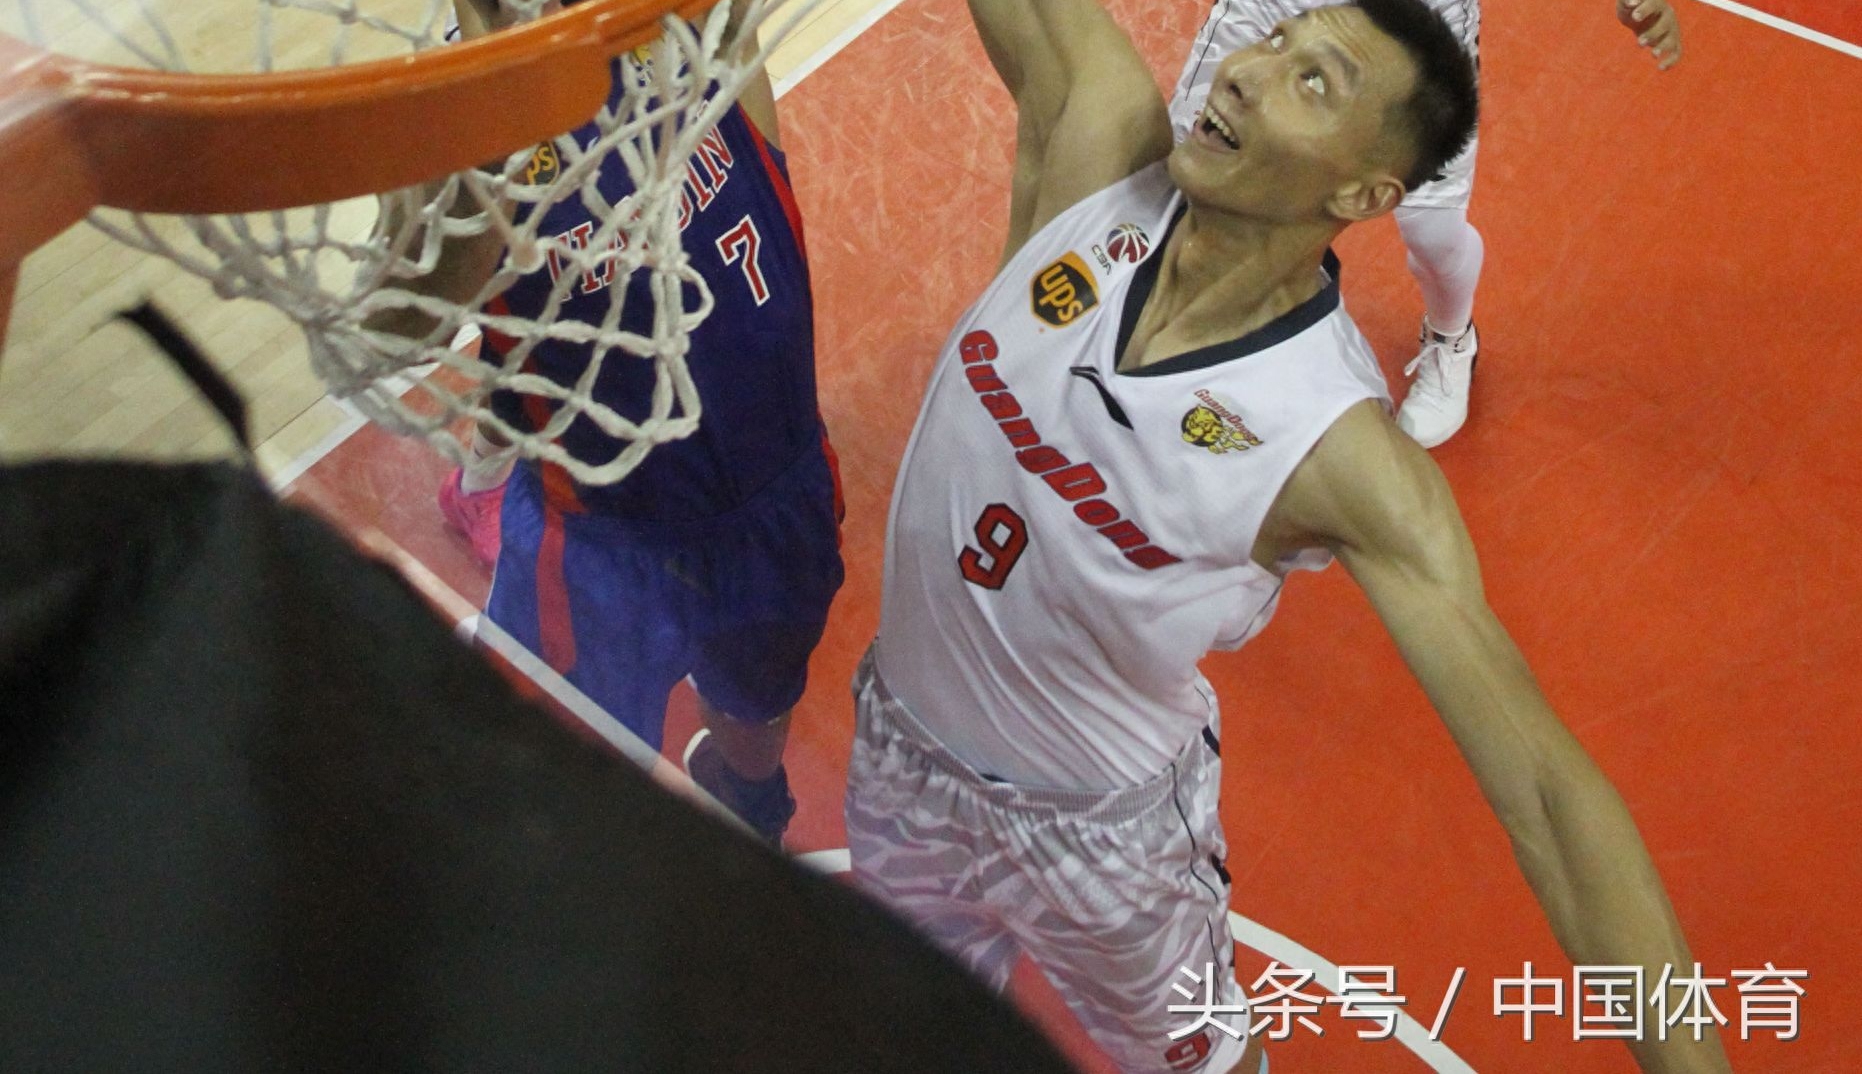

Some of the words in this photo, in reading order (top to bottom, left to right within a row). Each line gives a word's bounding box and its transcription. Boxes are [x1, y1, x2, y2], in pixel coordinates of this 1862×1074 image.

[527, 146, 555, 186] ps
[715, 214, 770, 306] 7
[1039, 265, 1083, 322] ups
[959, 330, 1183, 570] GuangDong
[958, 502, 1029, 591] 9
